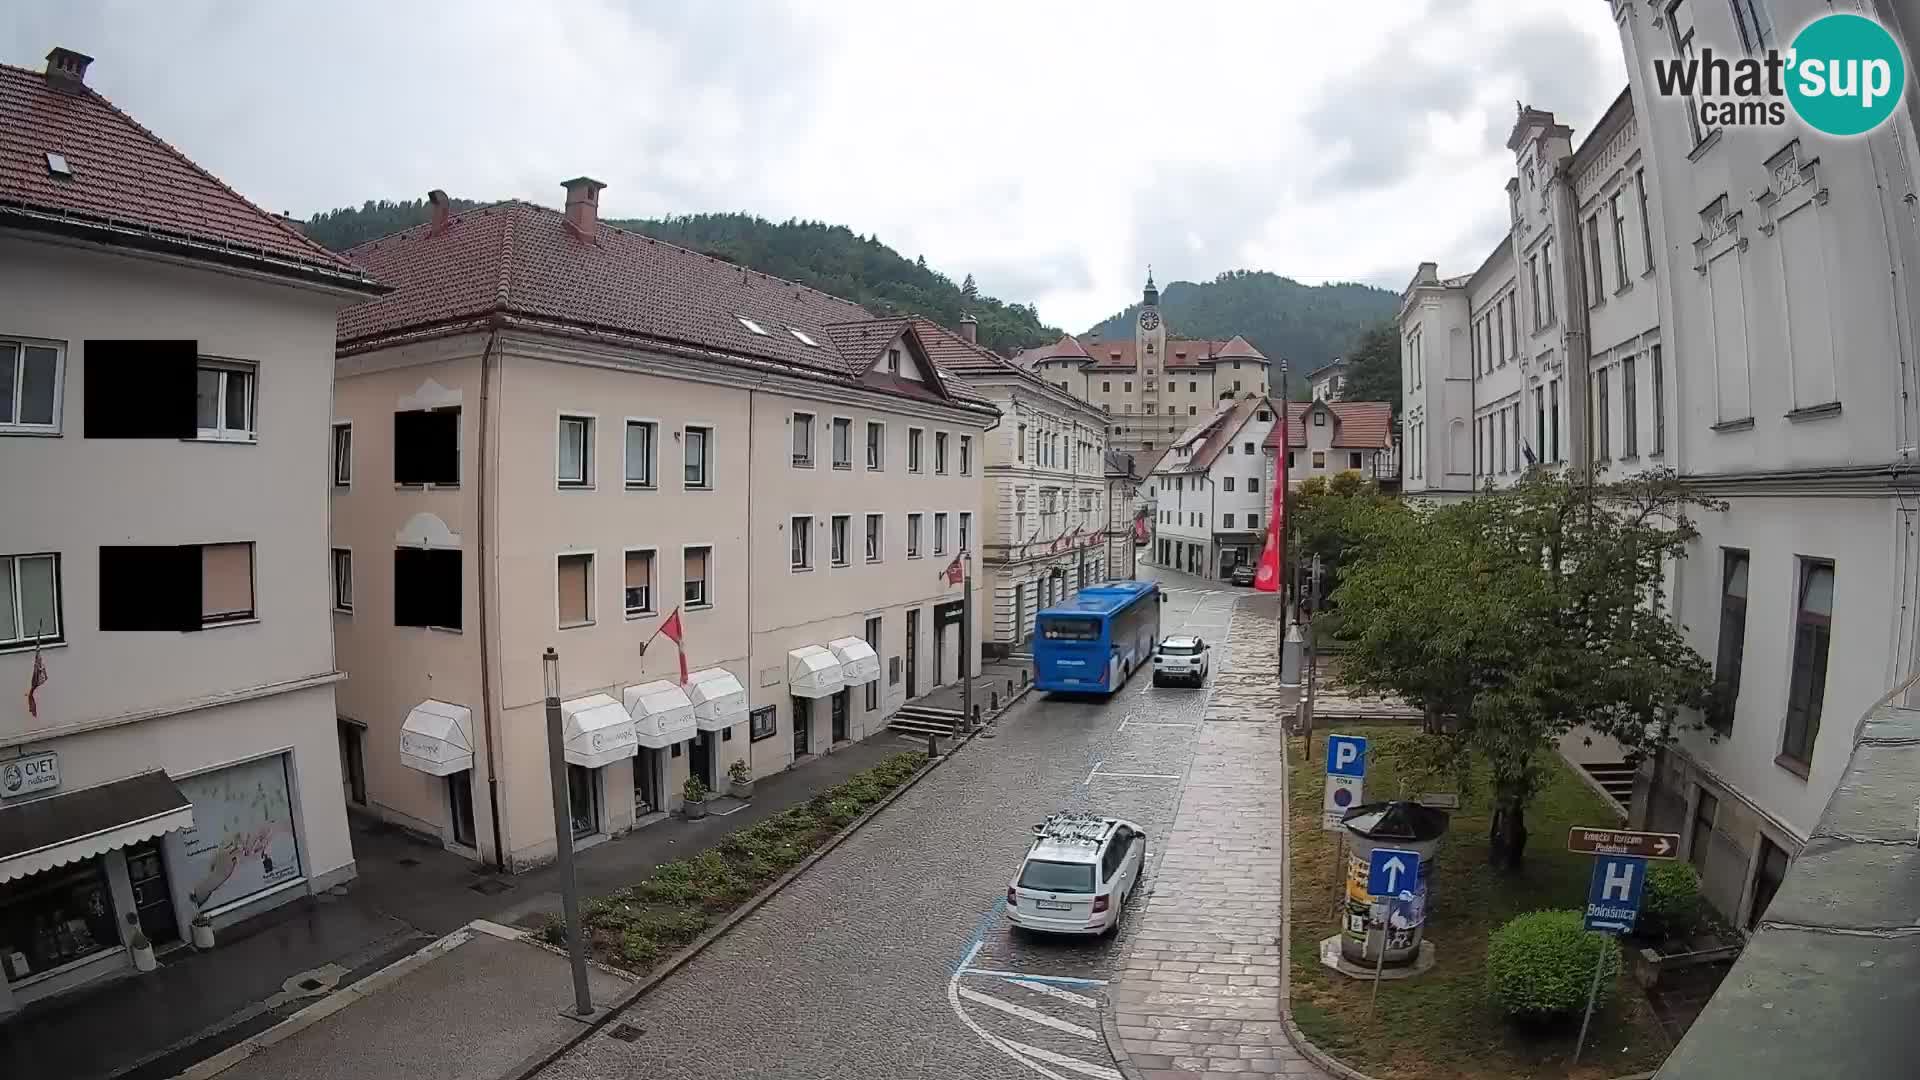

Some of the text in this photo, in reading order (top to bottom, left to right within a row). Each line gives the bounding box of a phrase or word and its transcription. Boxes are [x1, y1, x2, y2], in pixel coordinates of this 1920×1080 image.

[26, 759, 53, 776] CVET
[1336, 742, 1357, 769] P
[1602, 862, 1635, 900] H
